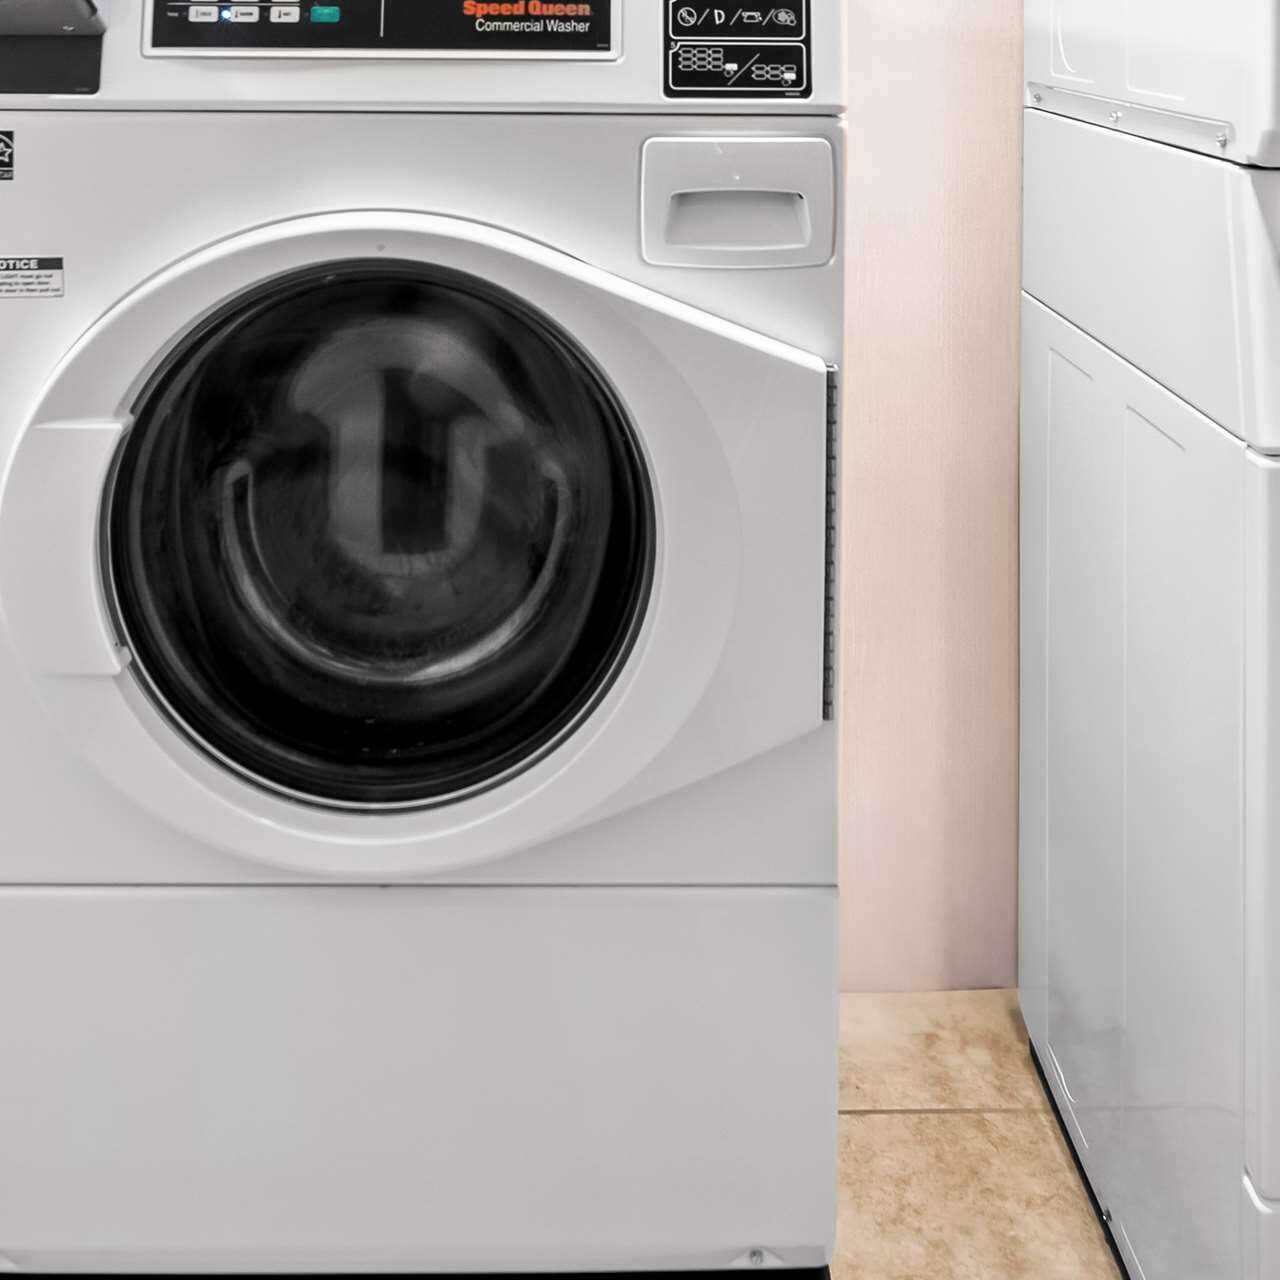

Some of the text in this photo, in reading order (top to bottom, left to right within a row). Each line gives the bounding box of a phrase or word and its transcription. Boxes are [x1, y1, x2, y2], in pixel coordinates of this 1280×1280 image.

[463, 0, 591, 18] Speed Queen
[475, 18, 590, 32] Commercial Washer
